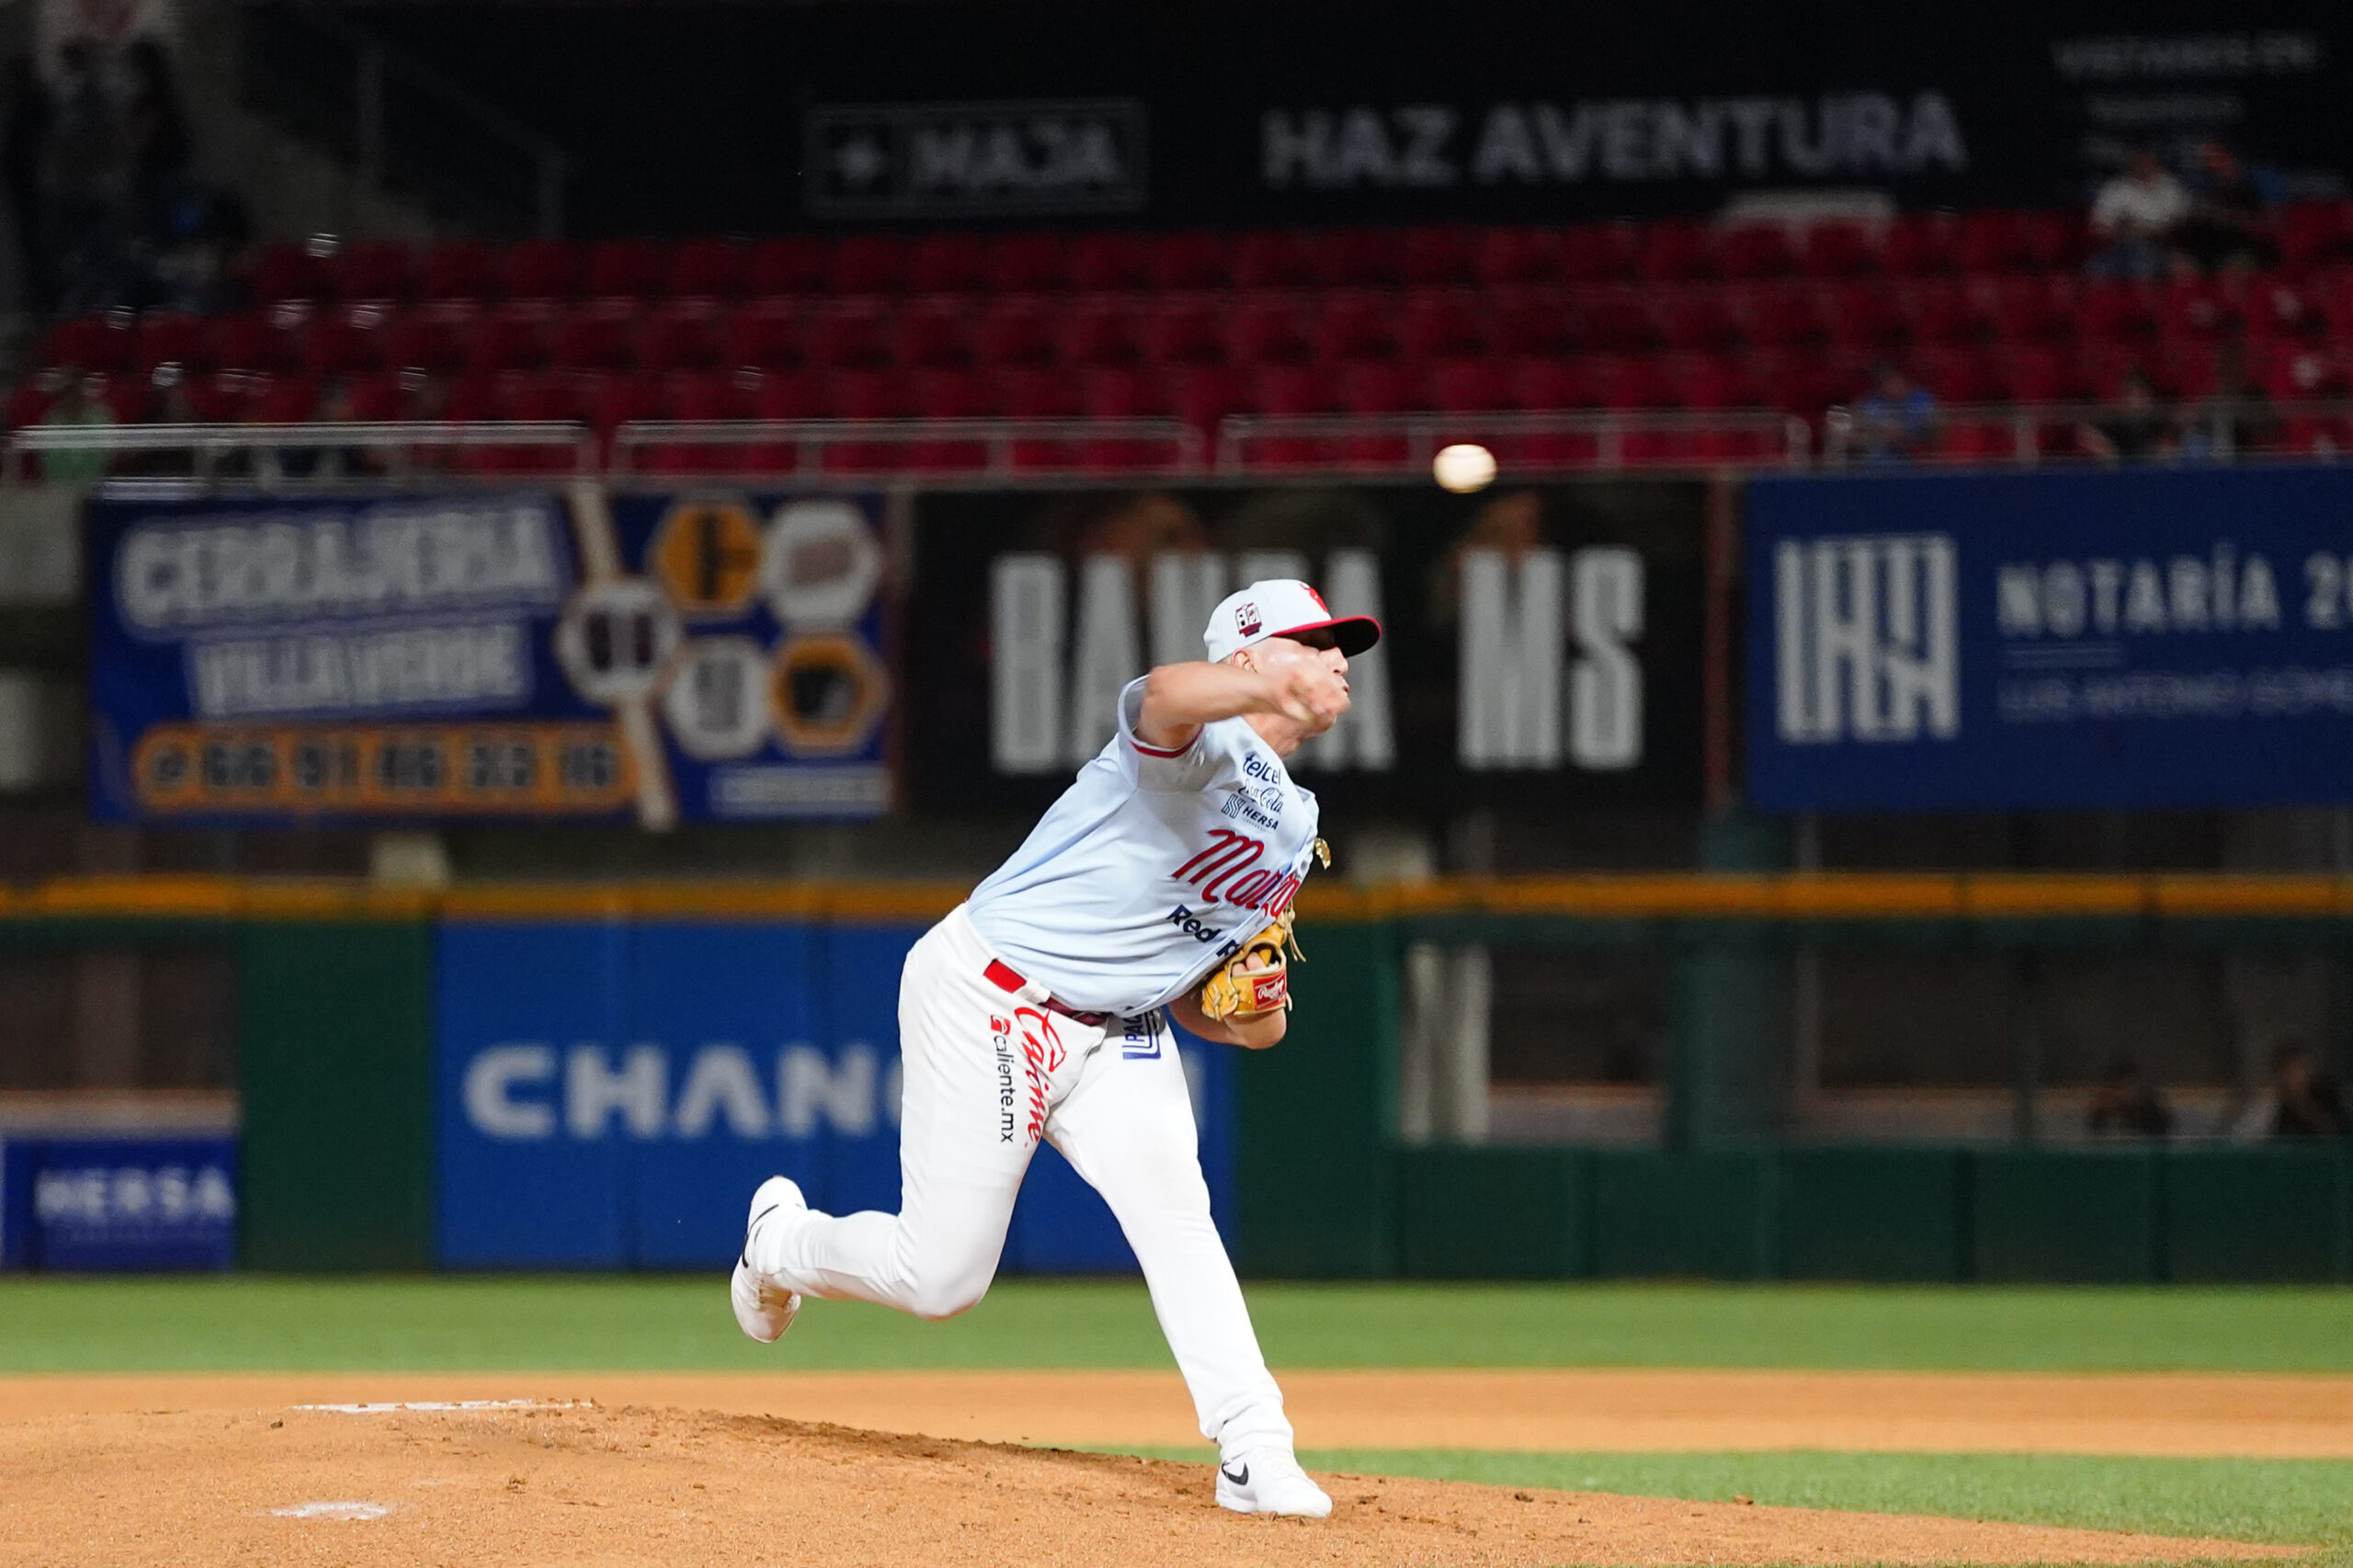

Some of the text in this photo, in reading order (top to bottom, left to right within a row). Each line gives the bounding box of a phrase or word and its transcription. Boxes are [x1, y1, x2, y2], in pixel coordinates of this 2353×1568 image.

[1261, 94, 1969, 184] HAZ AVENTURA
[1996, 540, 2353, 636] NOTARÍA 2
[1460, 548, 1644, 770] MS
[1243, 753, 1281, 787] telcel
[1242, 805, 1279, 831] HERSA
[1166, 904, 1222, 943] Red
[994, 1035, 1017, 1143] caliente.mx
[35, 1165, 236, 1225] HERSA
